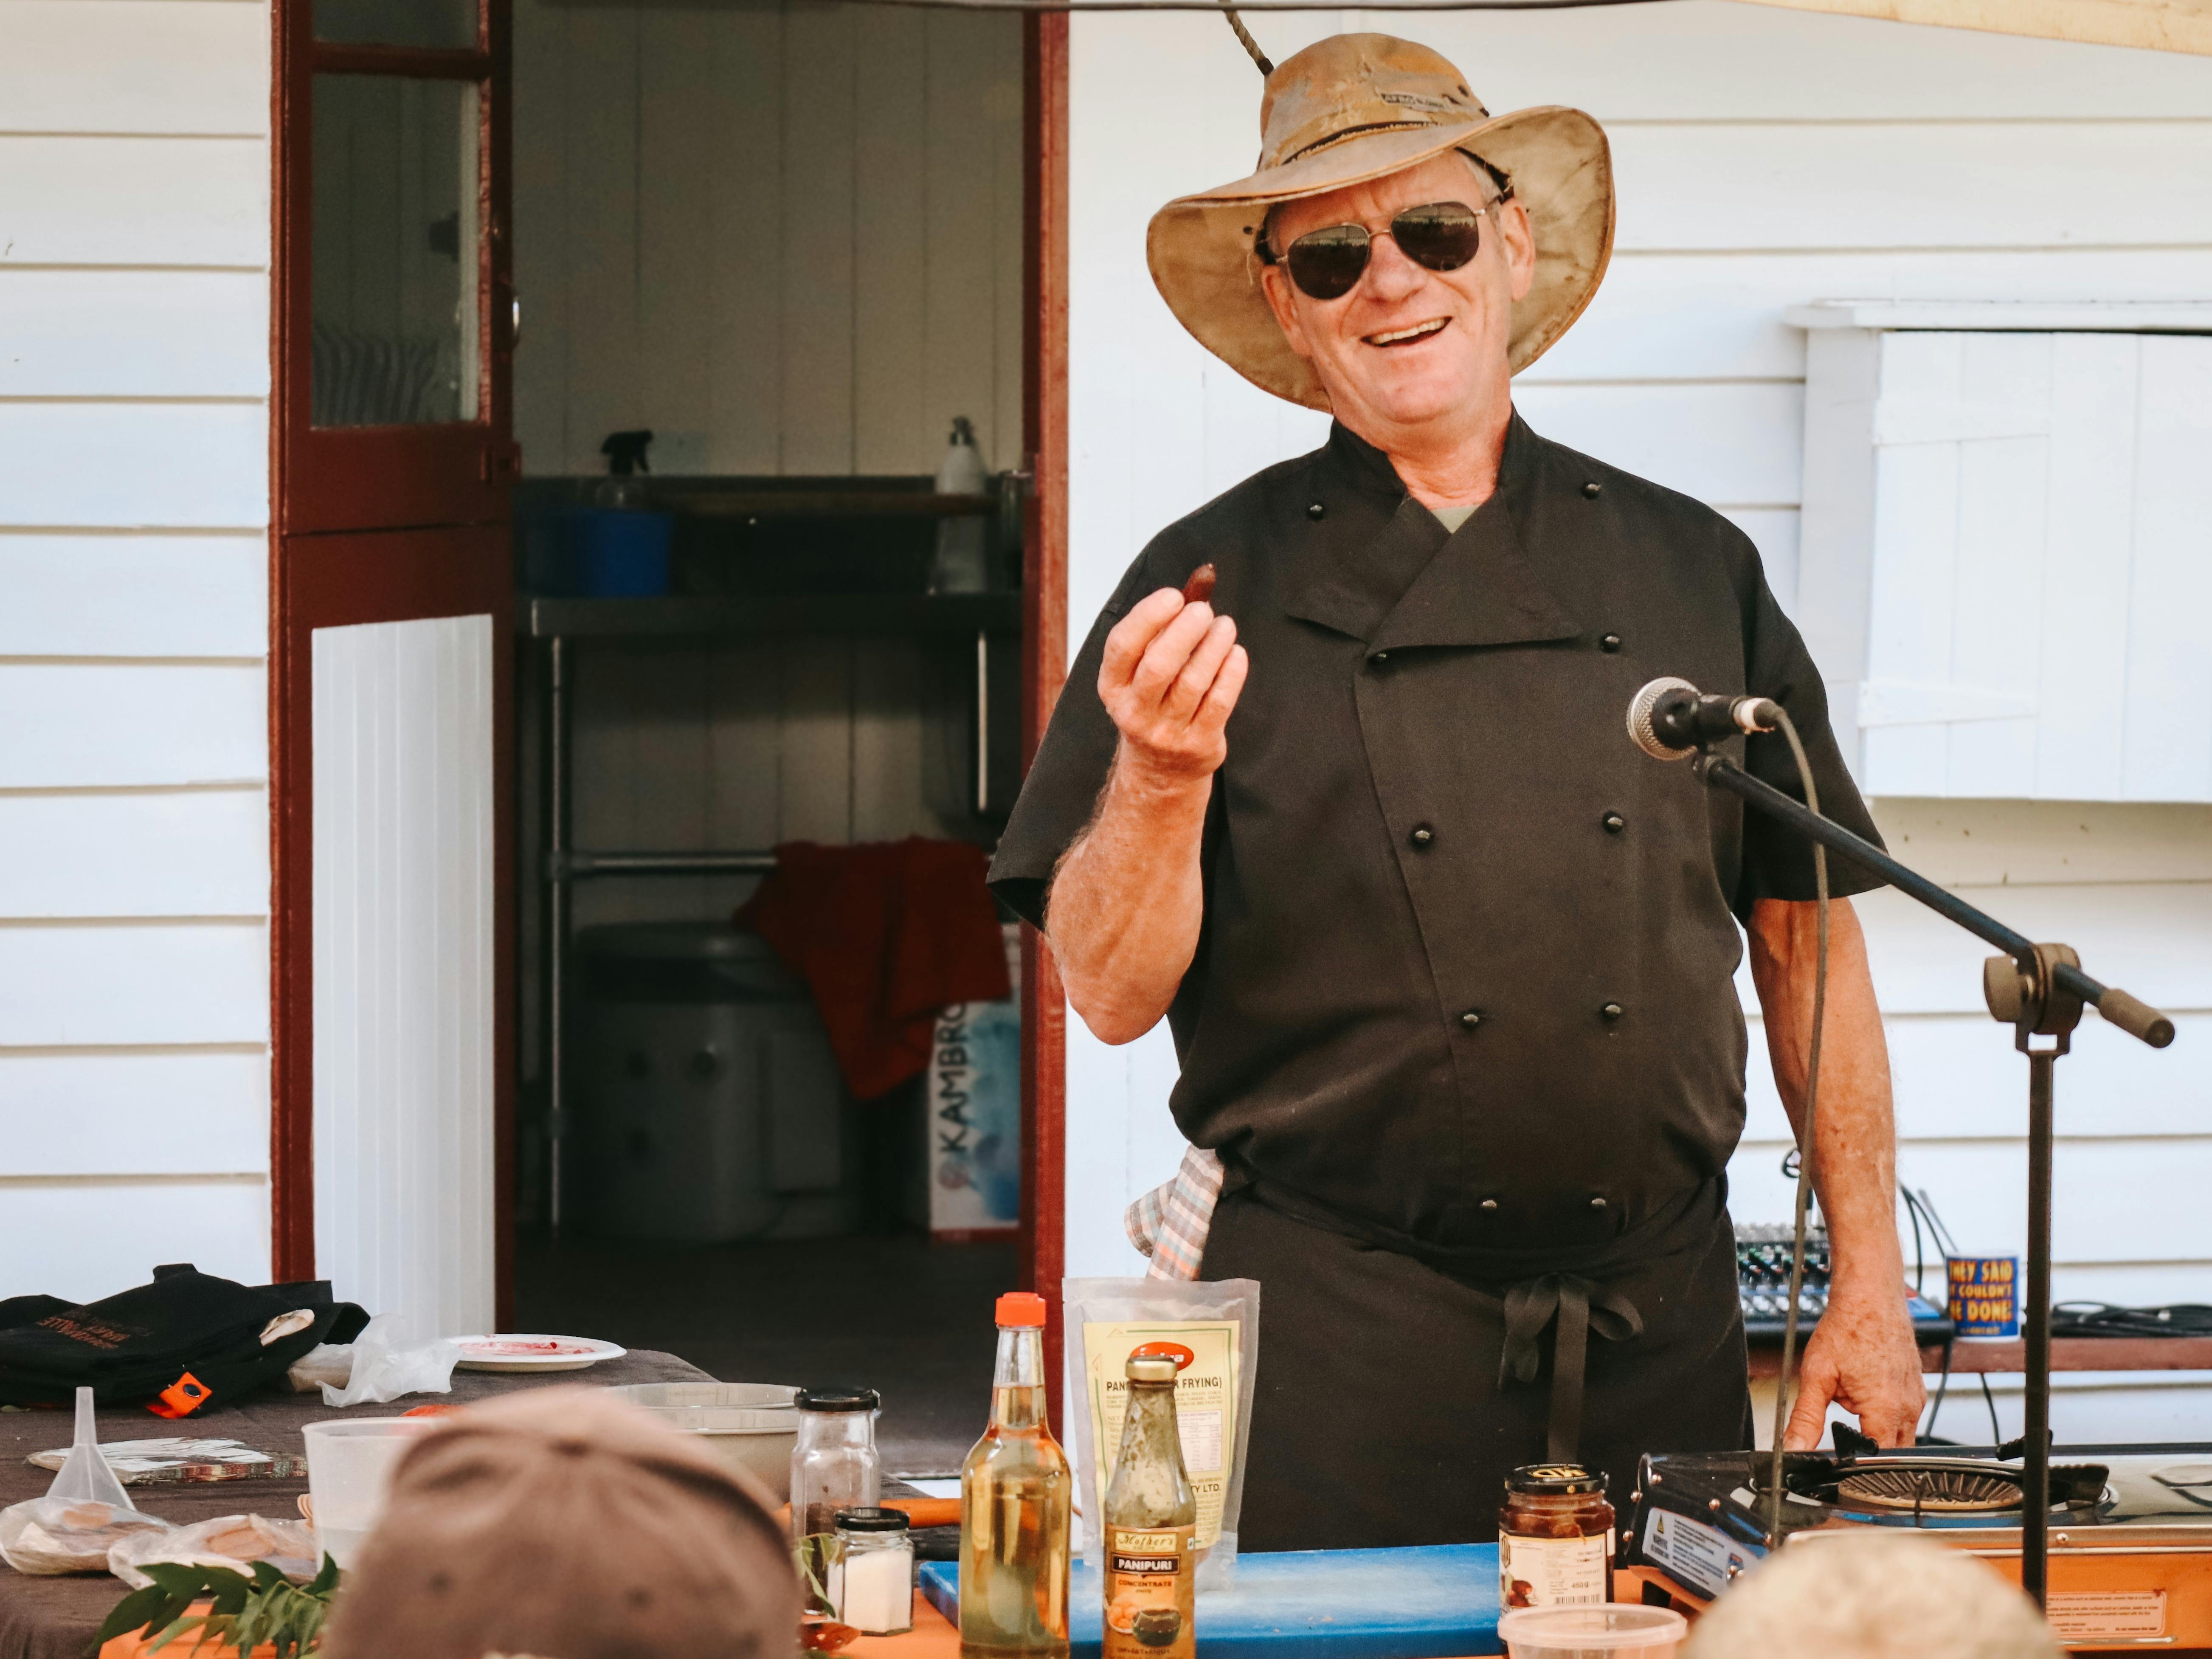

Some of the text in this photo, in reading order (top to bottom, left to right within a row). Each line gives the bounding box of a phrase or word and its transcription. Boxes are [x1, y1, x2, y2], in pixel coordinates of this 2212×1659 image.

[1949, 1260, 2014, 1283] THEY SAID
[1959, 1283, 2013, 1299] COULDN'T
[1203, 1483, 1221, 1492] LTD.
[1118, 1533, 1173, 1546] Mother's
[1118, 1559, 1172, 1570] PANIPURI
